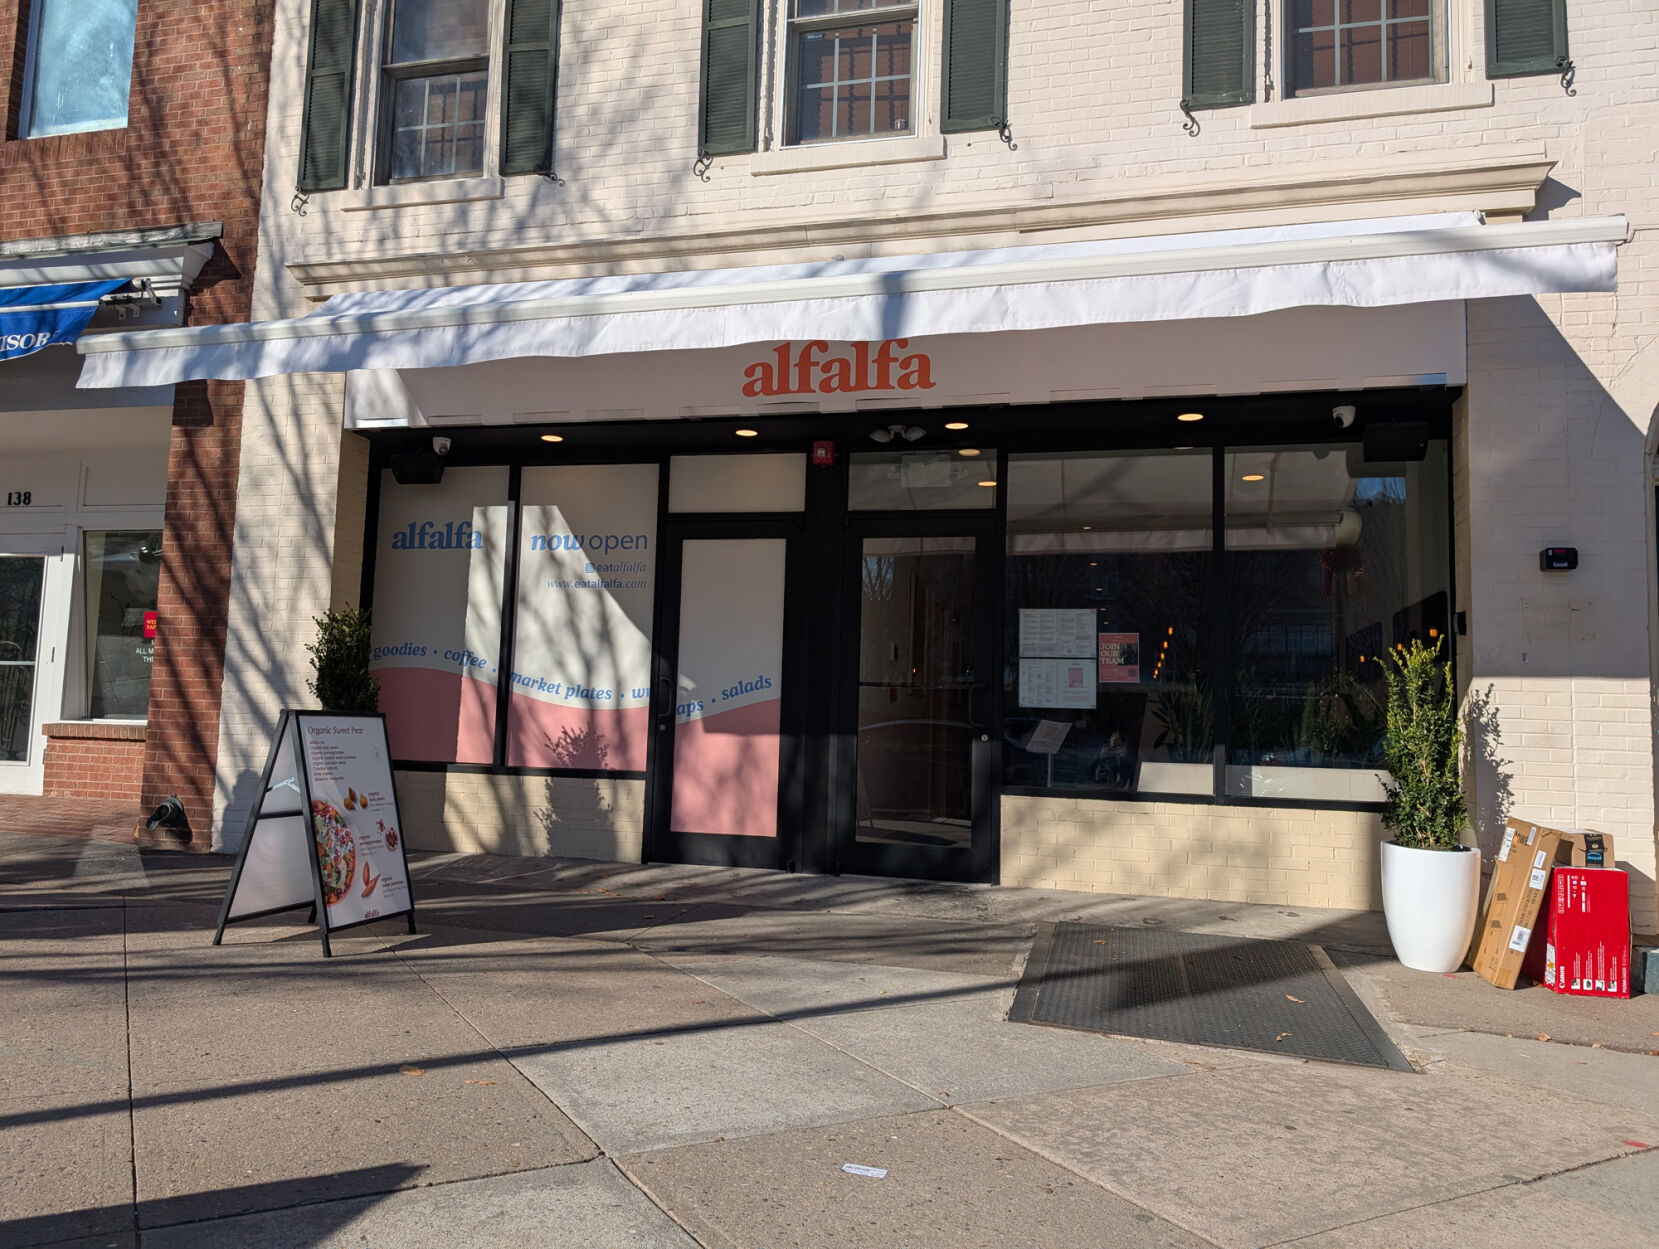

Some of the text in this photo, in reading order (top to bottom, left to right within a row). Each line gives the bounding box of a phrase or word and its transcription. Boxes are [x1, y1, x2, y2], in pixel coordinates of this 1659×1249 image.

[742, 338, 936, 397] alfalfa
[7, 491, 32, 506] 138
[391, 521, 484, 550] alfalfa
[531, 534, 648, 555] now open
[547, 578, 647, 589] www.eatalfalfa.com
[1100, 643, 1121, 651] JOIN
[1101, 657, 1125, 665] TEAM
[373, 642, 428, 661] goodies
[444, 649, 488, 669] coffee
[509, 672, 562, 695] market
[564, 684, 612, 700] plates
[721, 675, 772, 701] salads
[307, 726, 331, 736] Organic
[332, 726, 350, 735] Sweet
[1558, 965, 1566, 989] Canon
